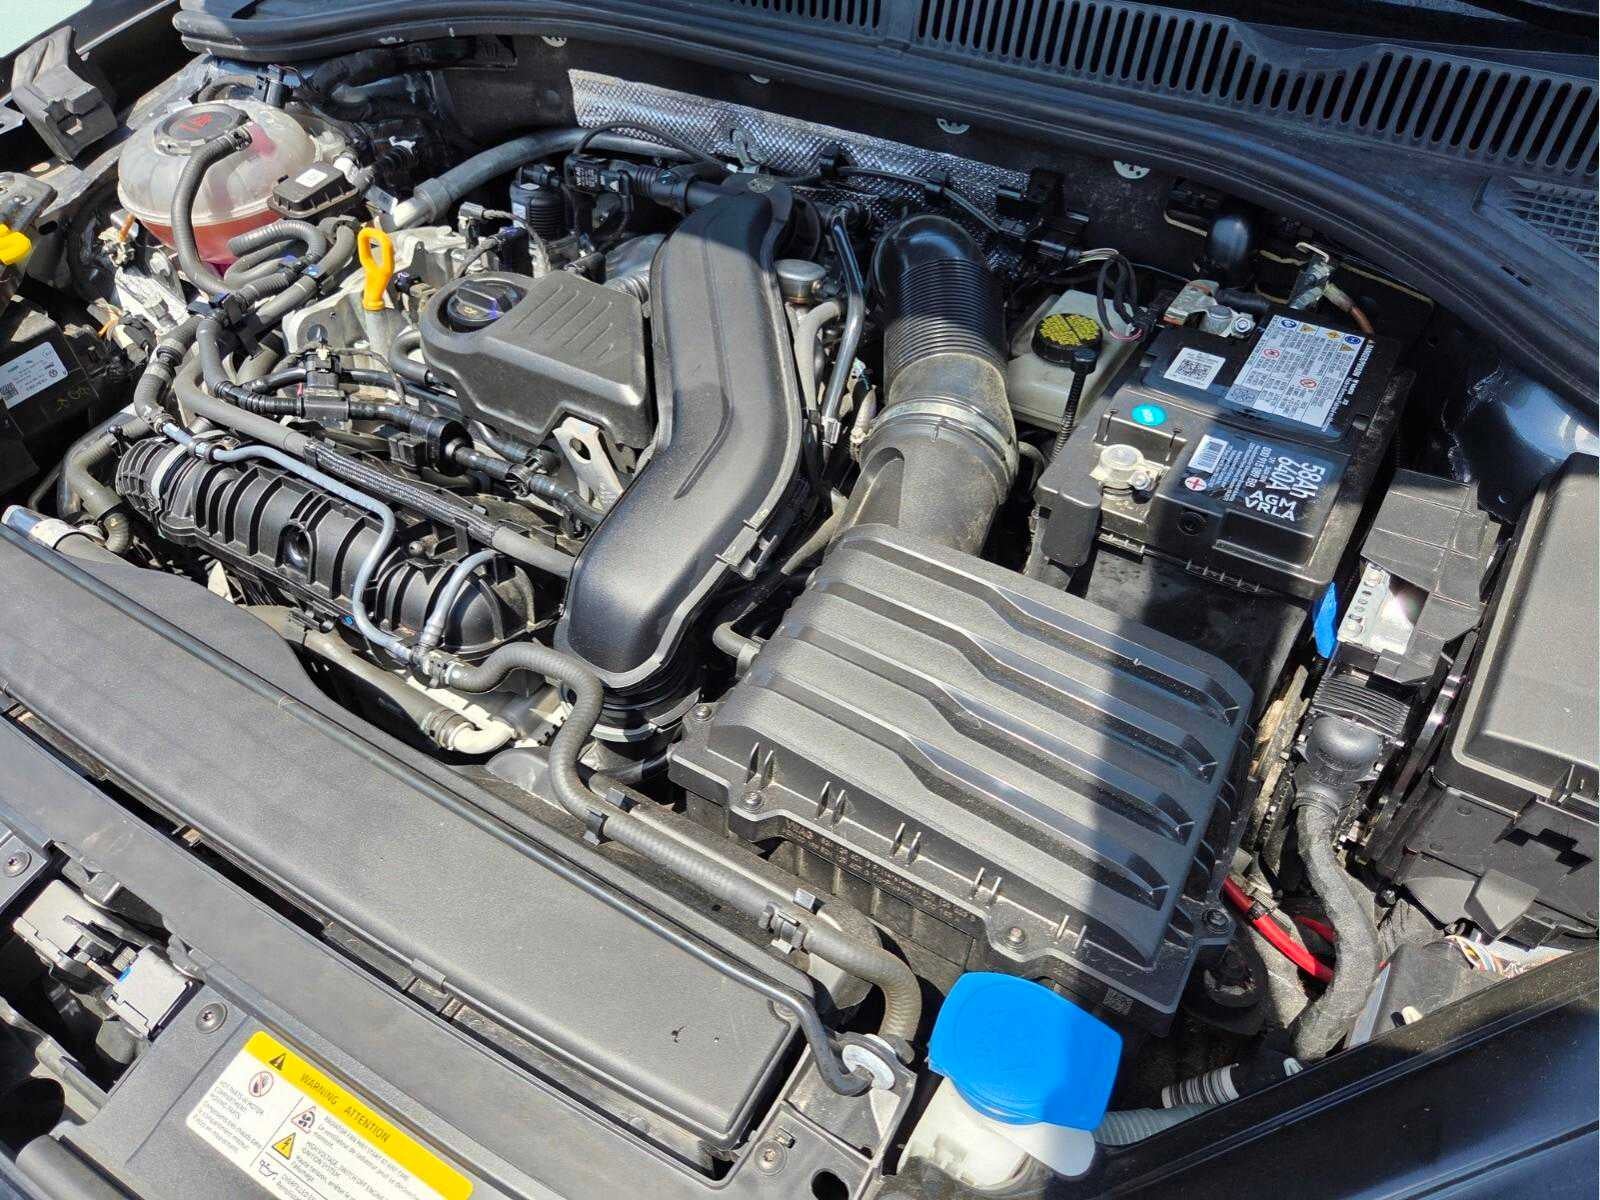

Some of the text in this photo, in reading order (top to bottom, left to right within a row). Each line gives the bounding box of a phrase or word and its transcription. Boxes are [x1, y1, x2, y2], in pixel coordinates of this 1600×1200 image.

[1265, 456, 1301, 490] 640A
[1289, 462, 1326, 499] 58Ah
[1245, 496, 1295, 521] VRLA
[1249, 490, 1297, 511] AGM
[300, 1072, 339, 1105] WARNING
[343, 1105, 391, 1143] ATTENTION
